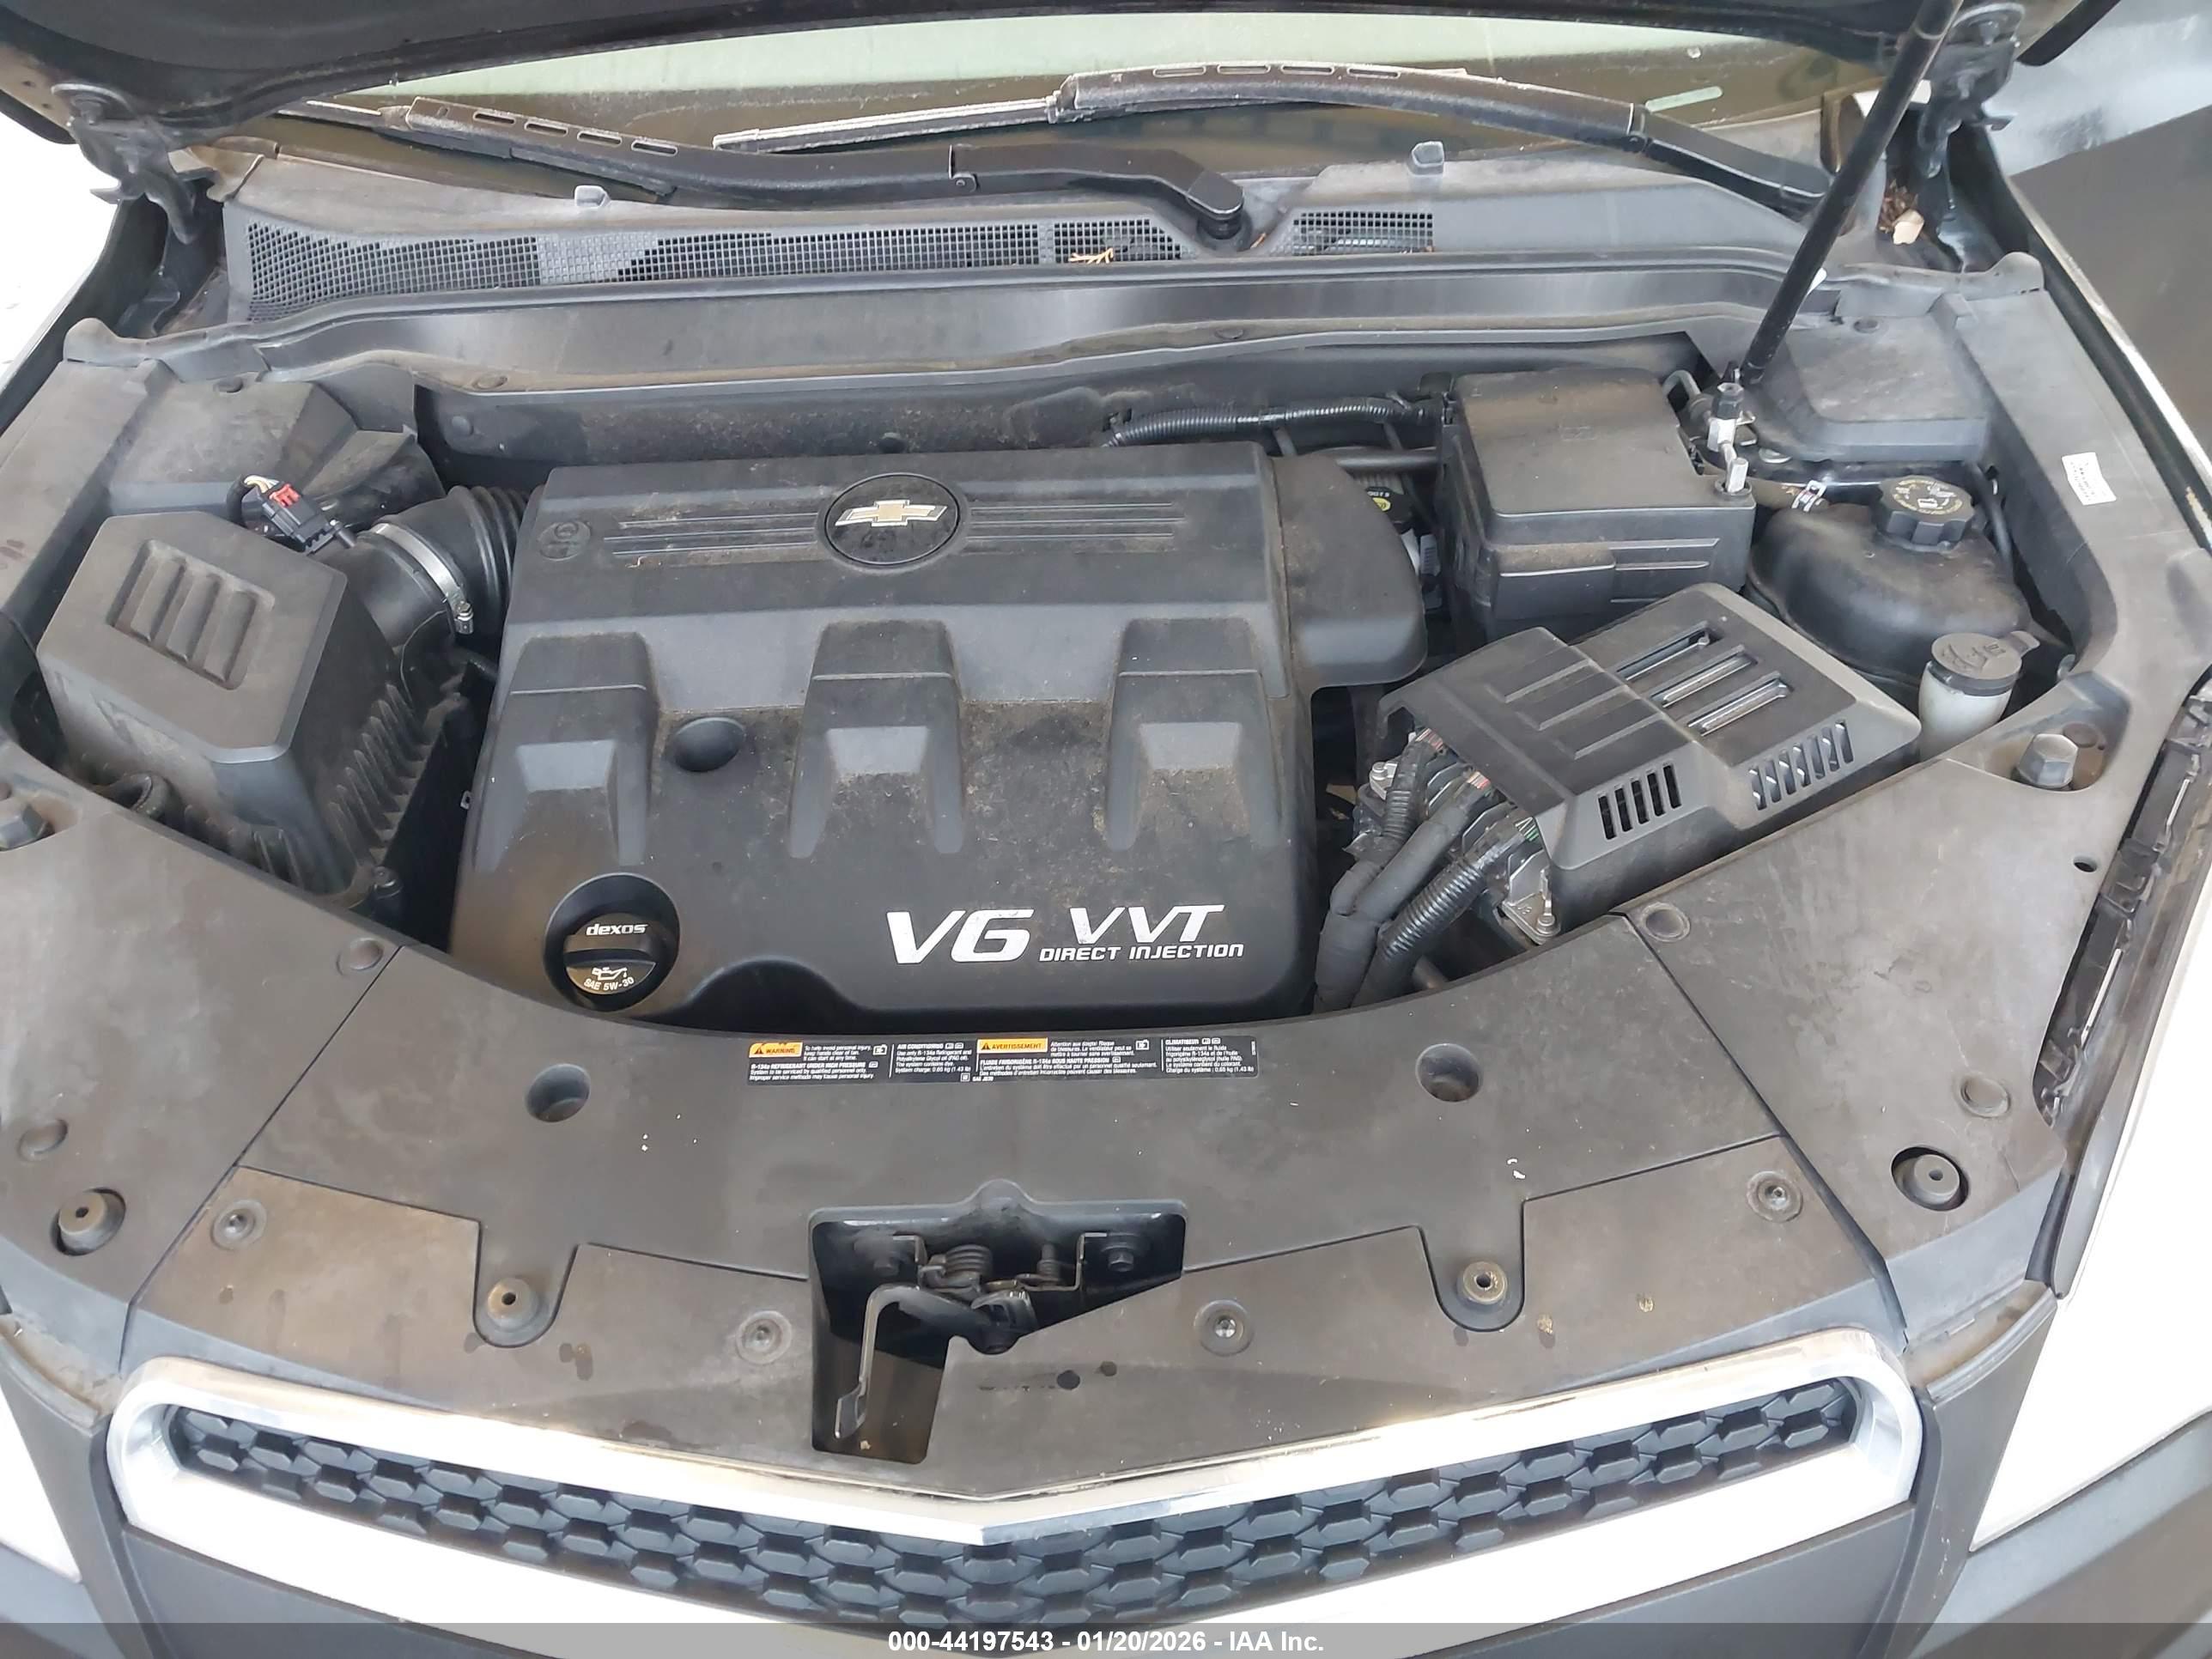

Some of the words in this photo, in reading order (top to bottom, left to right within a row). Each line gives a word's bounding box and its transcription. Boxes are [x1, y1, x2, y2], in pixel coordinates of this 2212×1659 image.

[586, 924, 648, 935] dexos
[886, 908, 1035, 964] V6
[1069, 904, 1224, 944] VVT
[1039, 946, 1121, 962] DIRECT
[1129, 944, 1244, 960] INJECTION
[584, 979, 601, 990] SAE
[604, 977, 635, 991] 5W-30
